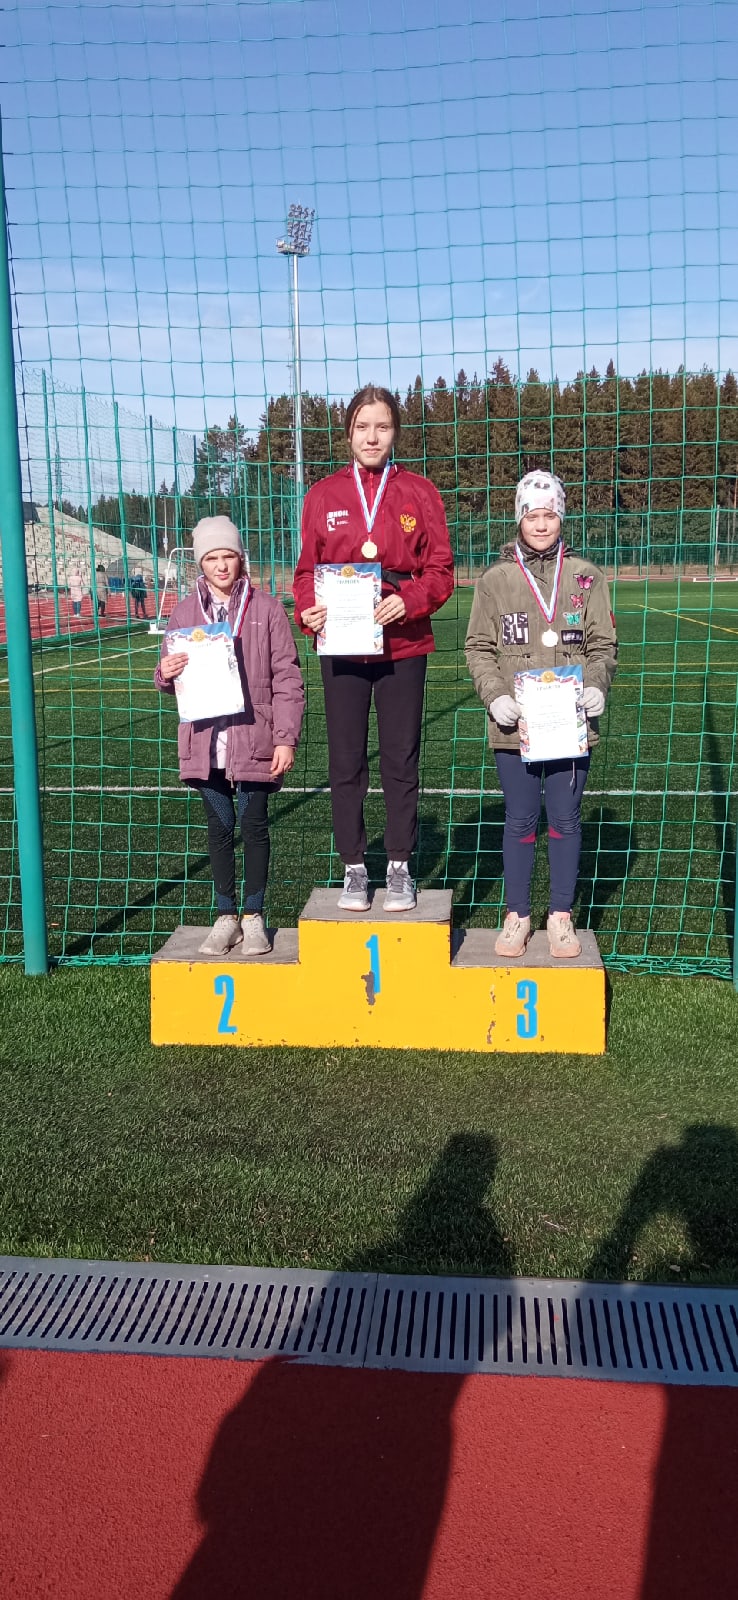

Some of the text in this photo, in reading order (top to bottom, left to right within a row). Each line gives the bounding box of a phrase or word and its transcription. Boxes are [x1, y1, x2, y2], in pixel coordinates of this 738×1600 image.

[365, 934, 381, 995] 1
[214, 974, 238, 1034] 2
[516, 979, 538, 1039] 3
